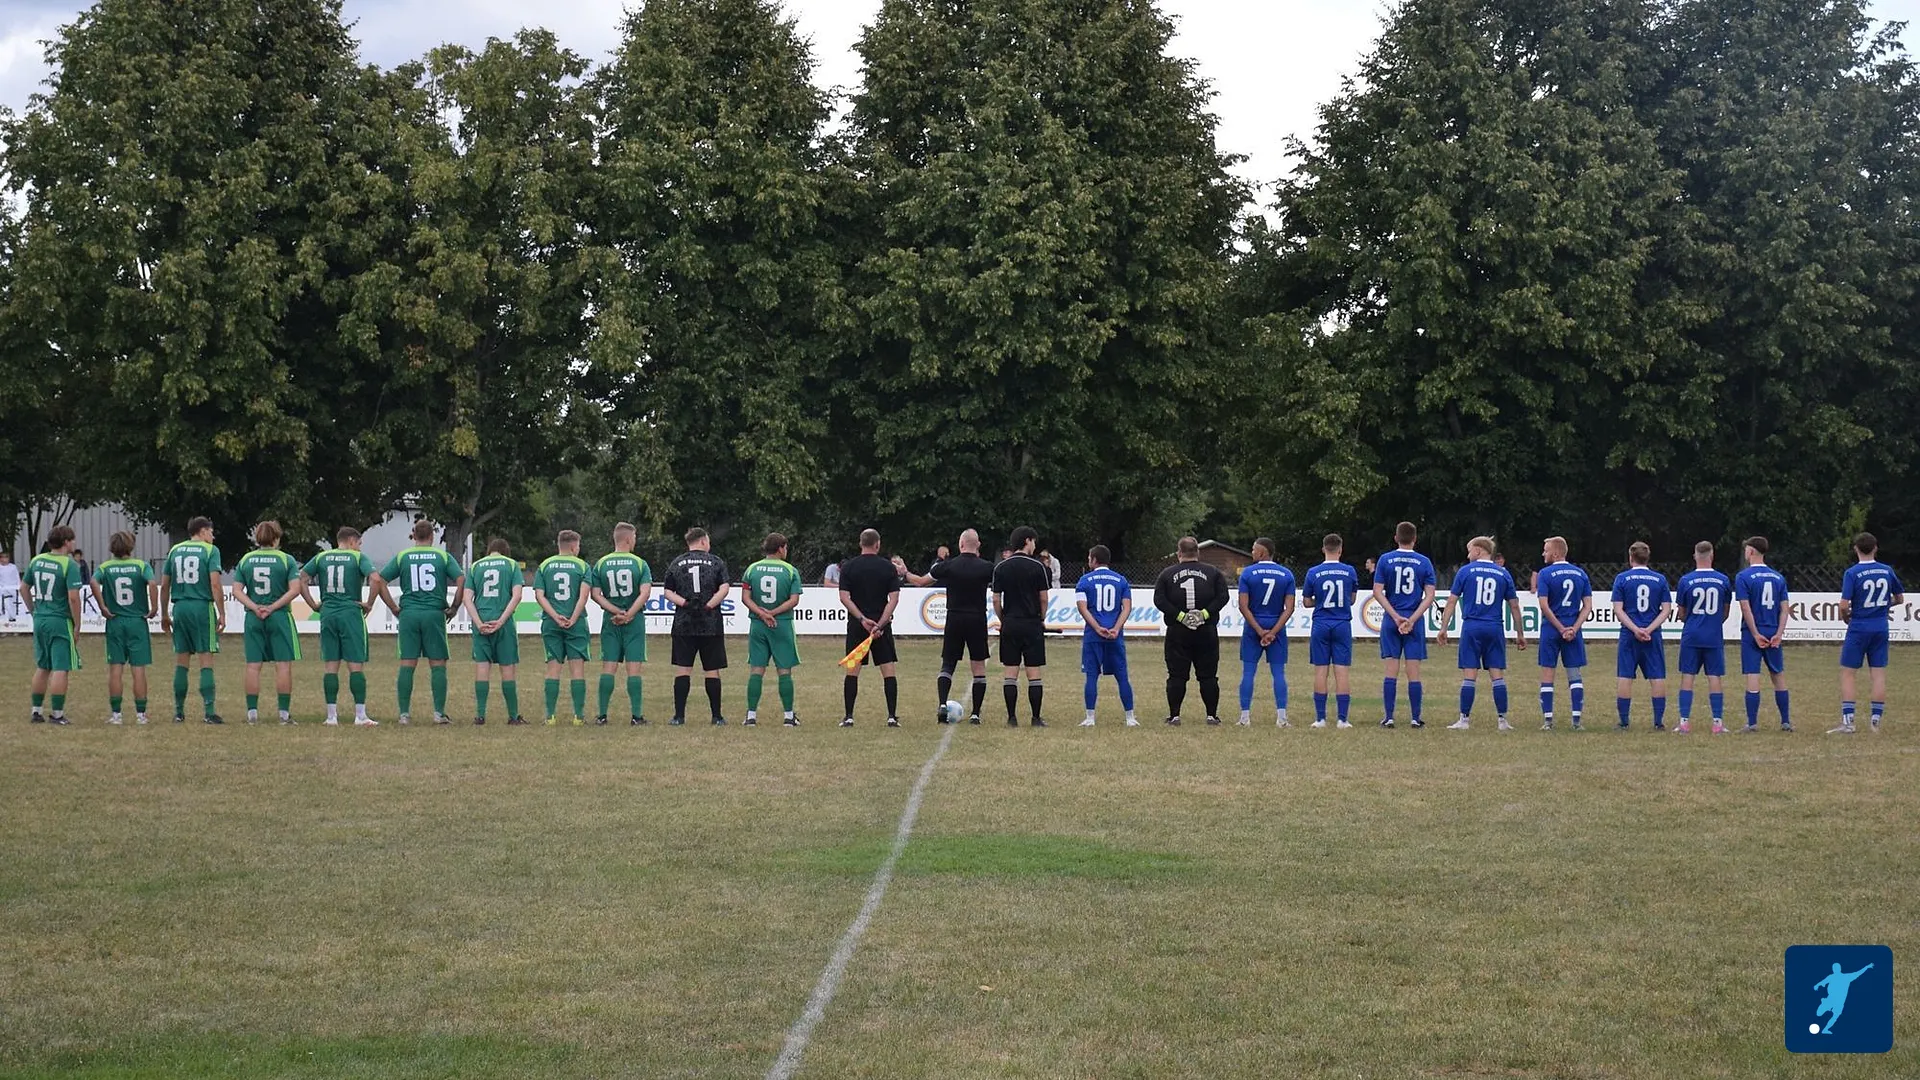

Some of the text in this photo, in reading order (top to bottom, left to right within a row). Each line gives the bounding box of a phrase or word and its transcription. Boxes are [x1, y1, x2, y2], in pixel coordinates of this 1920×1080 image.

[174, 556, 200, 584] 18
[253, 567, 271, 595] 5
[326, 565, 345, 593] 11
[410, 563, 436, 592] 16
[483, 569, 500, 597] 2
[606, 568, 633, 598] 19
[688, 566, 701, 593] 1
[1395, 567, 1415, 595] 13
[34, 571, 56, 601] 17
[115, 577, 134, 606] 6
[553, 572, 570, 601] 3
[760, 576, 777, 604] 9
[1094, 584, 1116, 612] 10
[1180, 578, 1195, 610] 1
[1263, 579, 1276, 606] 7
[1322, 580, 1344, 608] 21
[1476, 577, 1496, 605] 18
[1562, 579, 1574, 607] 2
[1636, 584, 1650, 612] 8
[1762, 581, 1774, 610] 4
[1862, 578, 1888, 608] 22
[1692, 587, 1719, 615] 20
